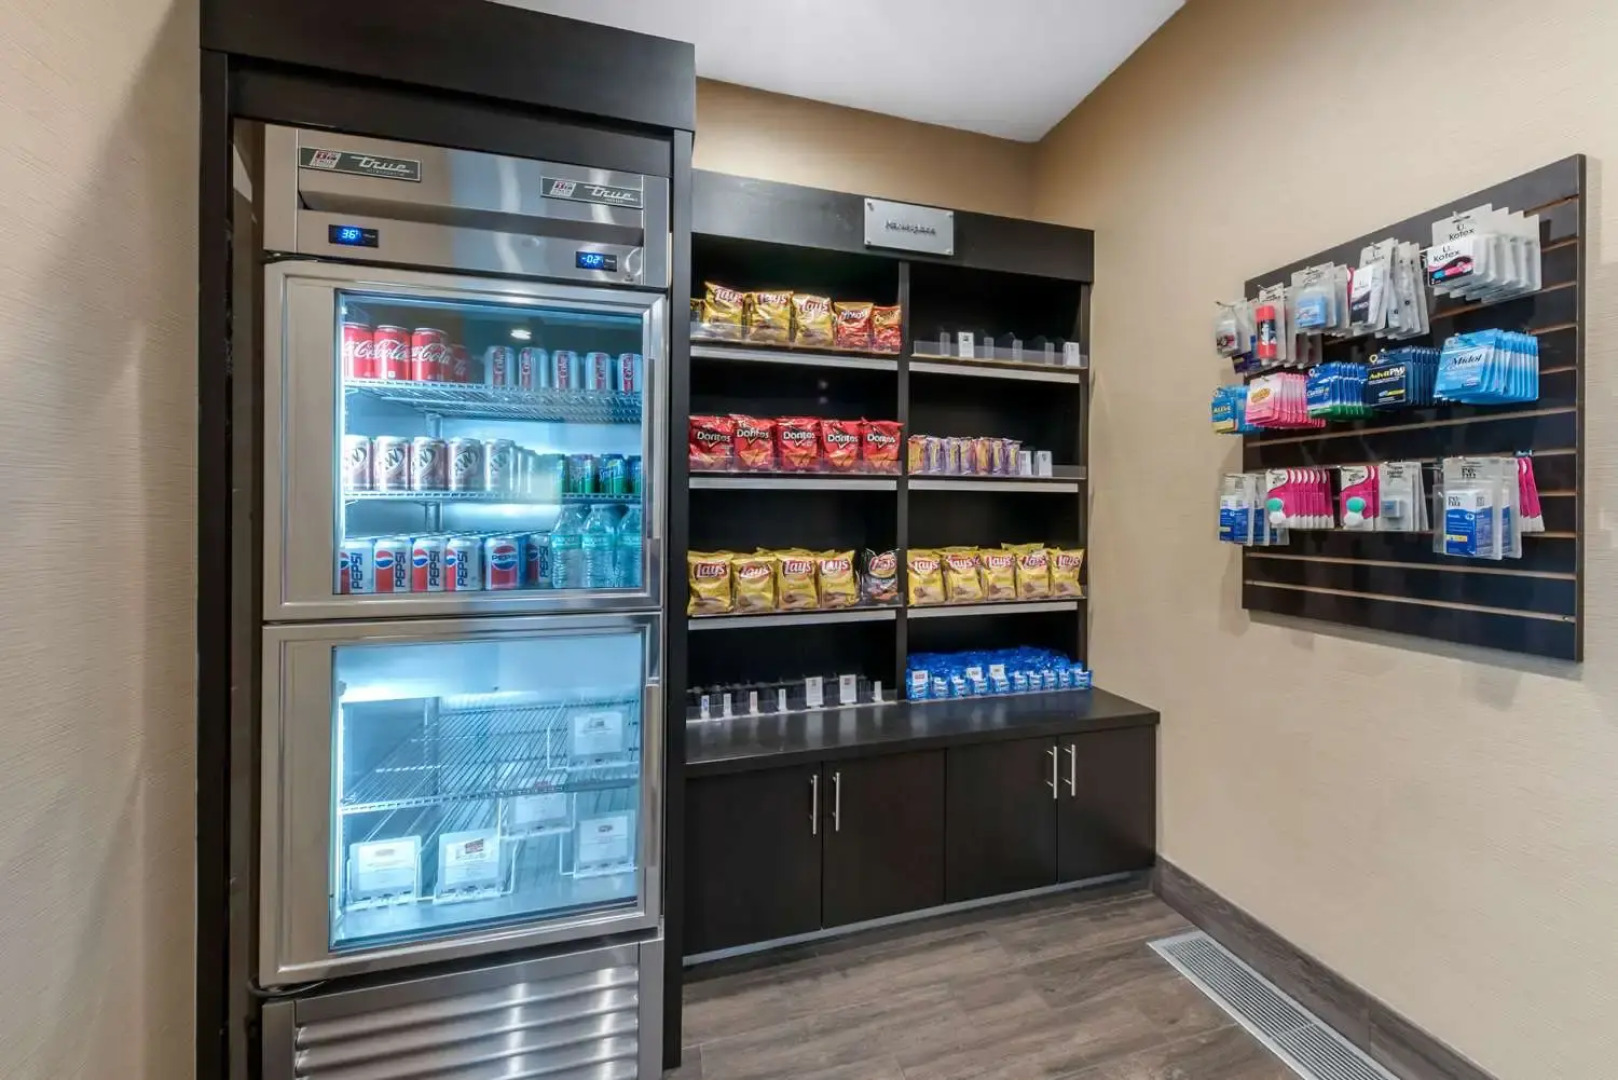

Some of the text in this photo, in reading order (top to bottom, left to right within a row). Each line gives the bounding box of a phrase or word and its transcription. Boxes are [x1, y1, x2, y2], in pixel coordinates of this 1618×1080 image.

[1449, 229, 1475, 240] Kotex
[1433, 250, 1460, 262] Kotex
[1452, 354, 1483, 365] Midol
[697, 430, 731, 443] Doritos
[736, 428, 770, 440] Doritos
[783, 430, 815, 441] Doritos
[828, 433, 859, 444] Doritos
[867, 432, 896, 443] Doritos
[352, 552, 363, 589] PEPSI
[395, 551, 406, 588] PEPSI
[429, 550, 440, 587] PEPSI
[457, 550, 468, 587] PEPSI
